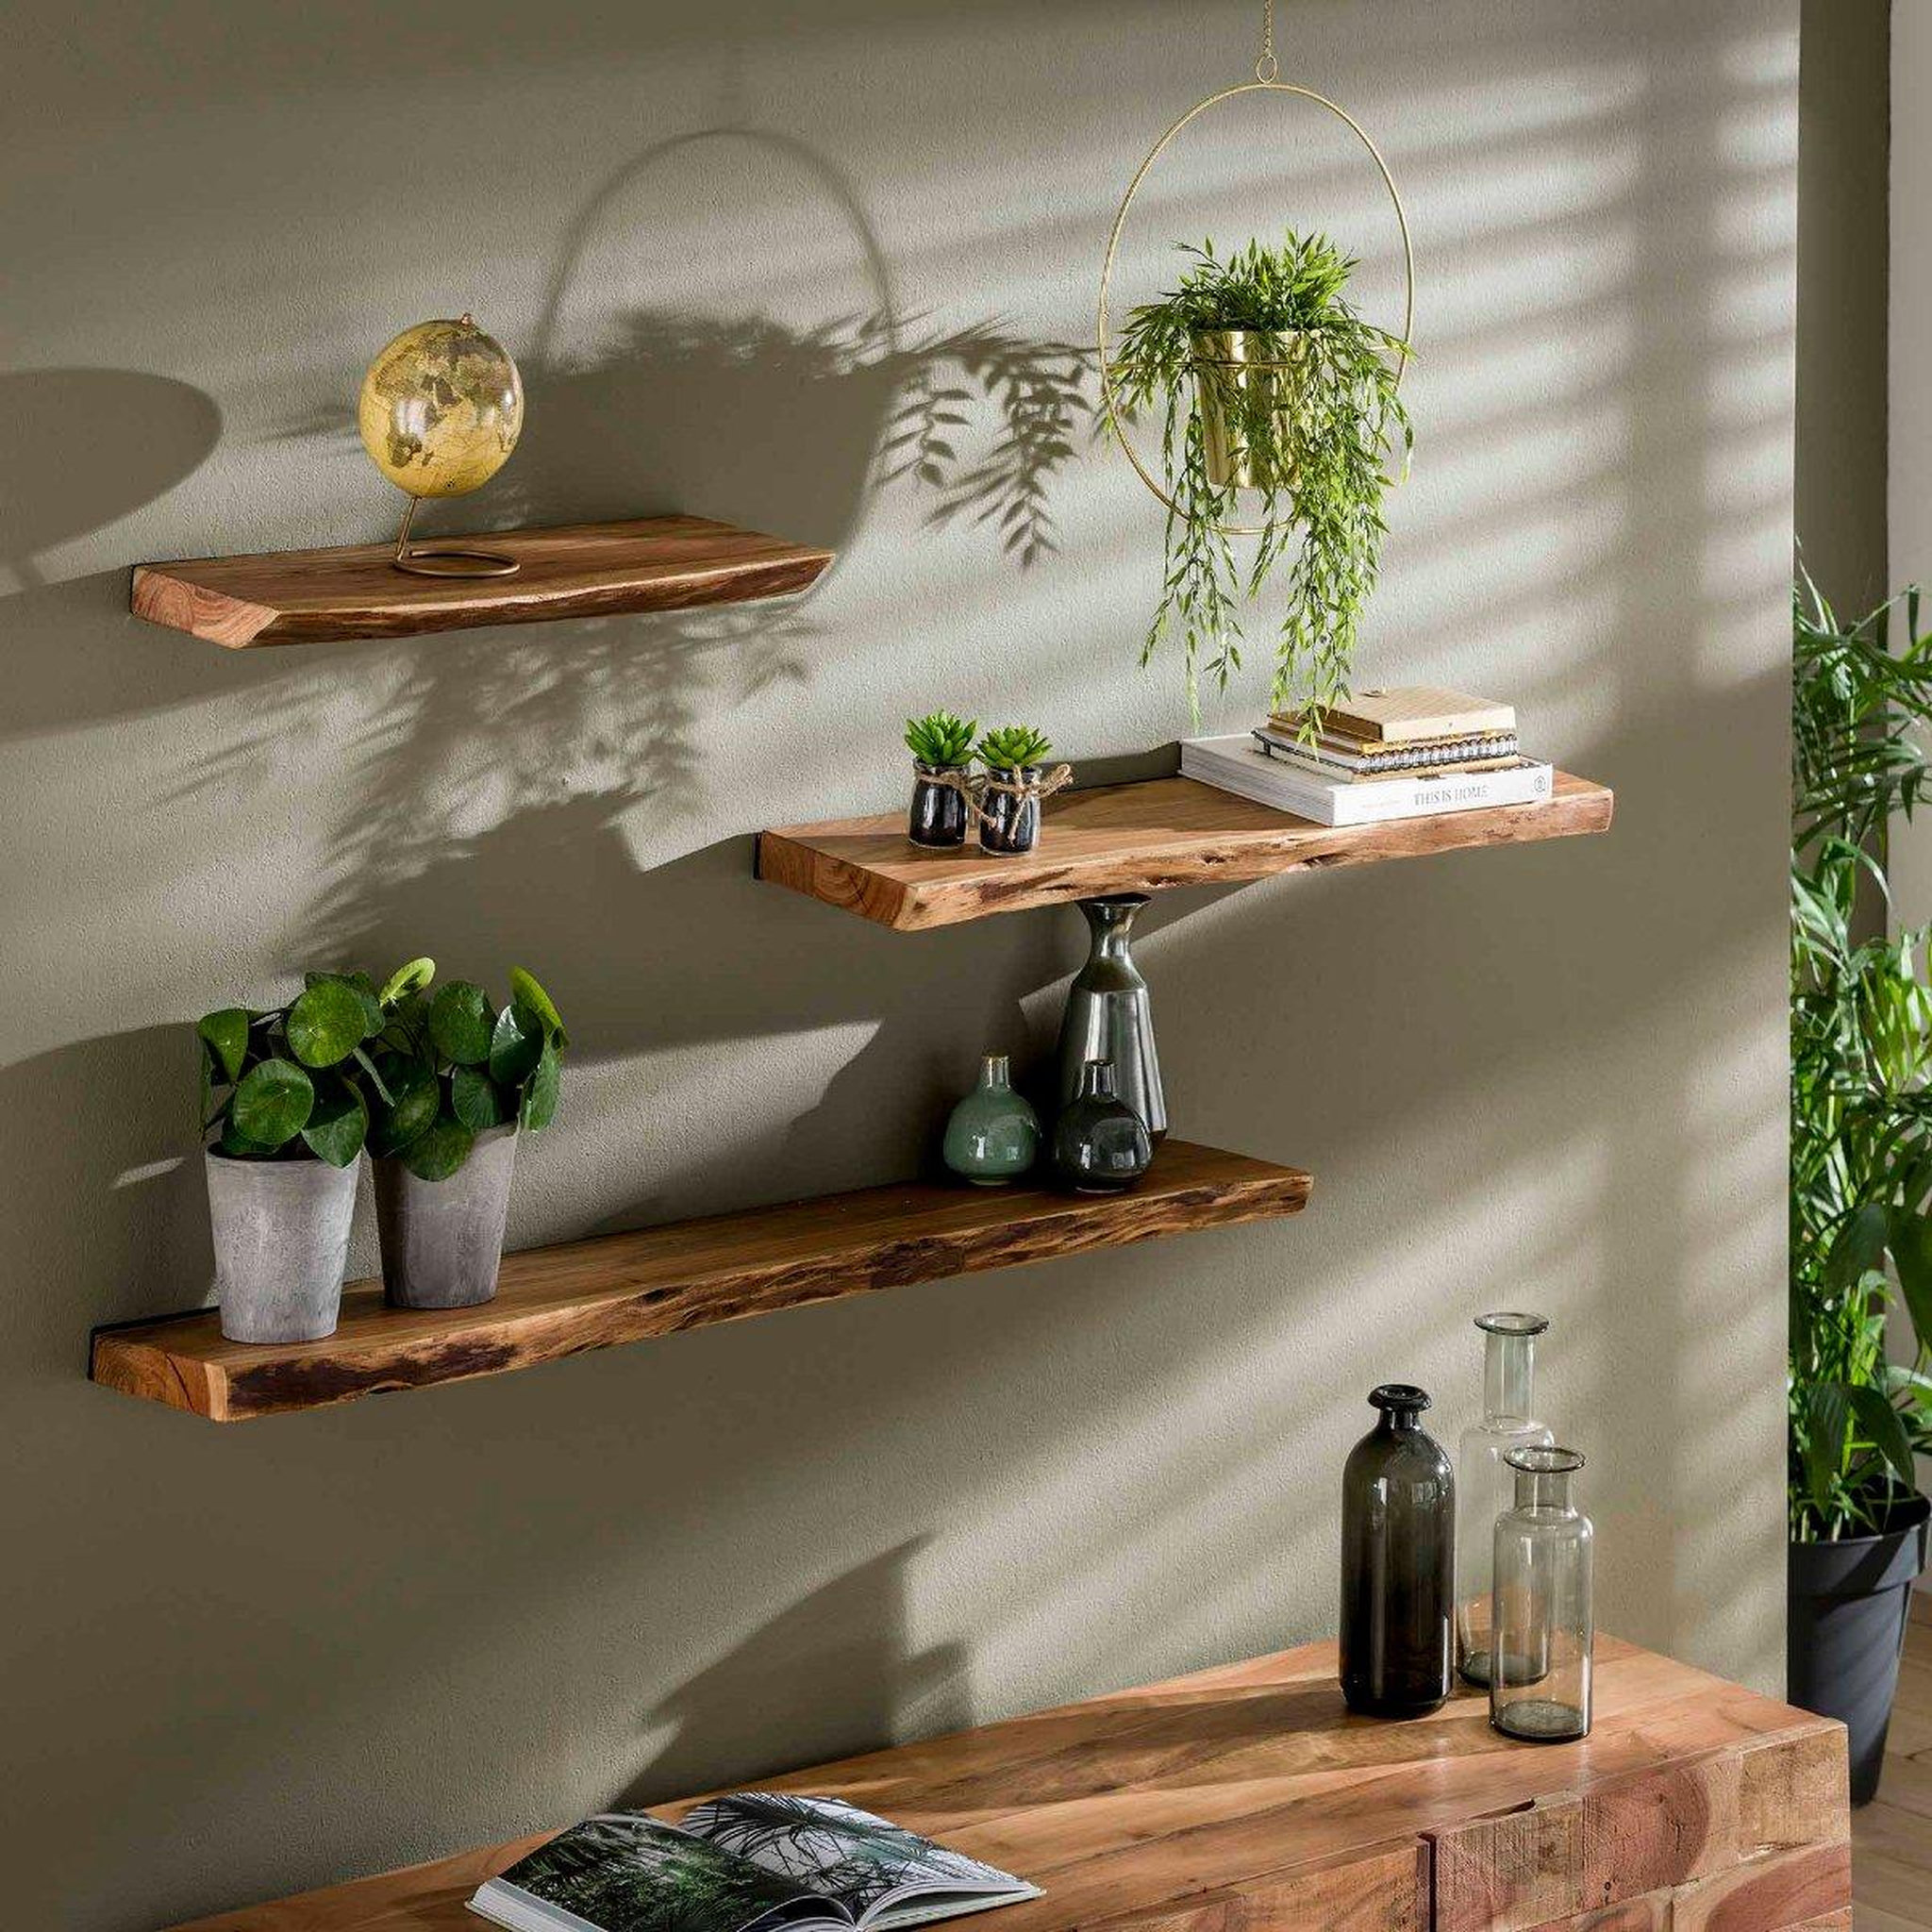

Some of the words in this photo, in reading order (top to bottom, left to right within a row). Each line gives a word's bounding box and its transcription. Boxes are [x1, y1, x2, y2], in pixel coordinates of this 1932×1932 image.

[1414, 791, 1440, 807] THIS
[1441, 789, 1452, 803] IS
[1455, 785, 1489, 801] HOME
